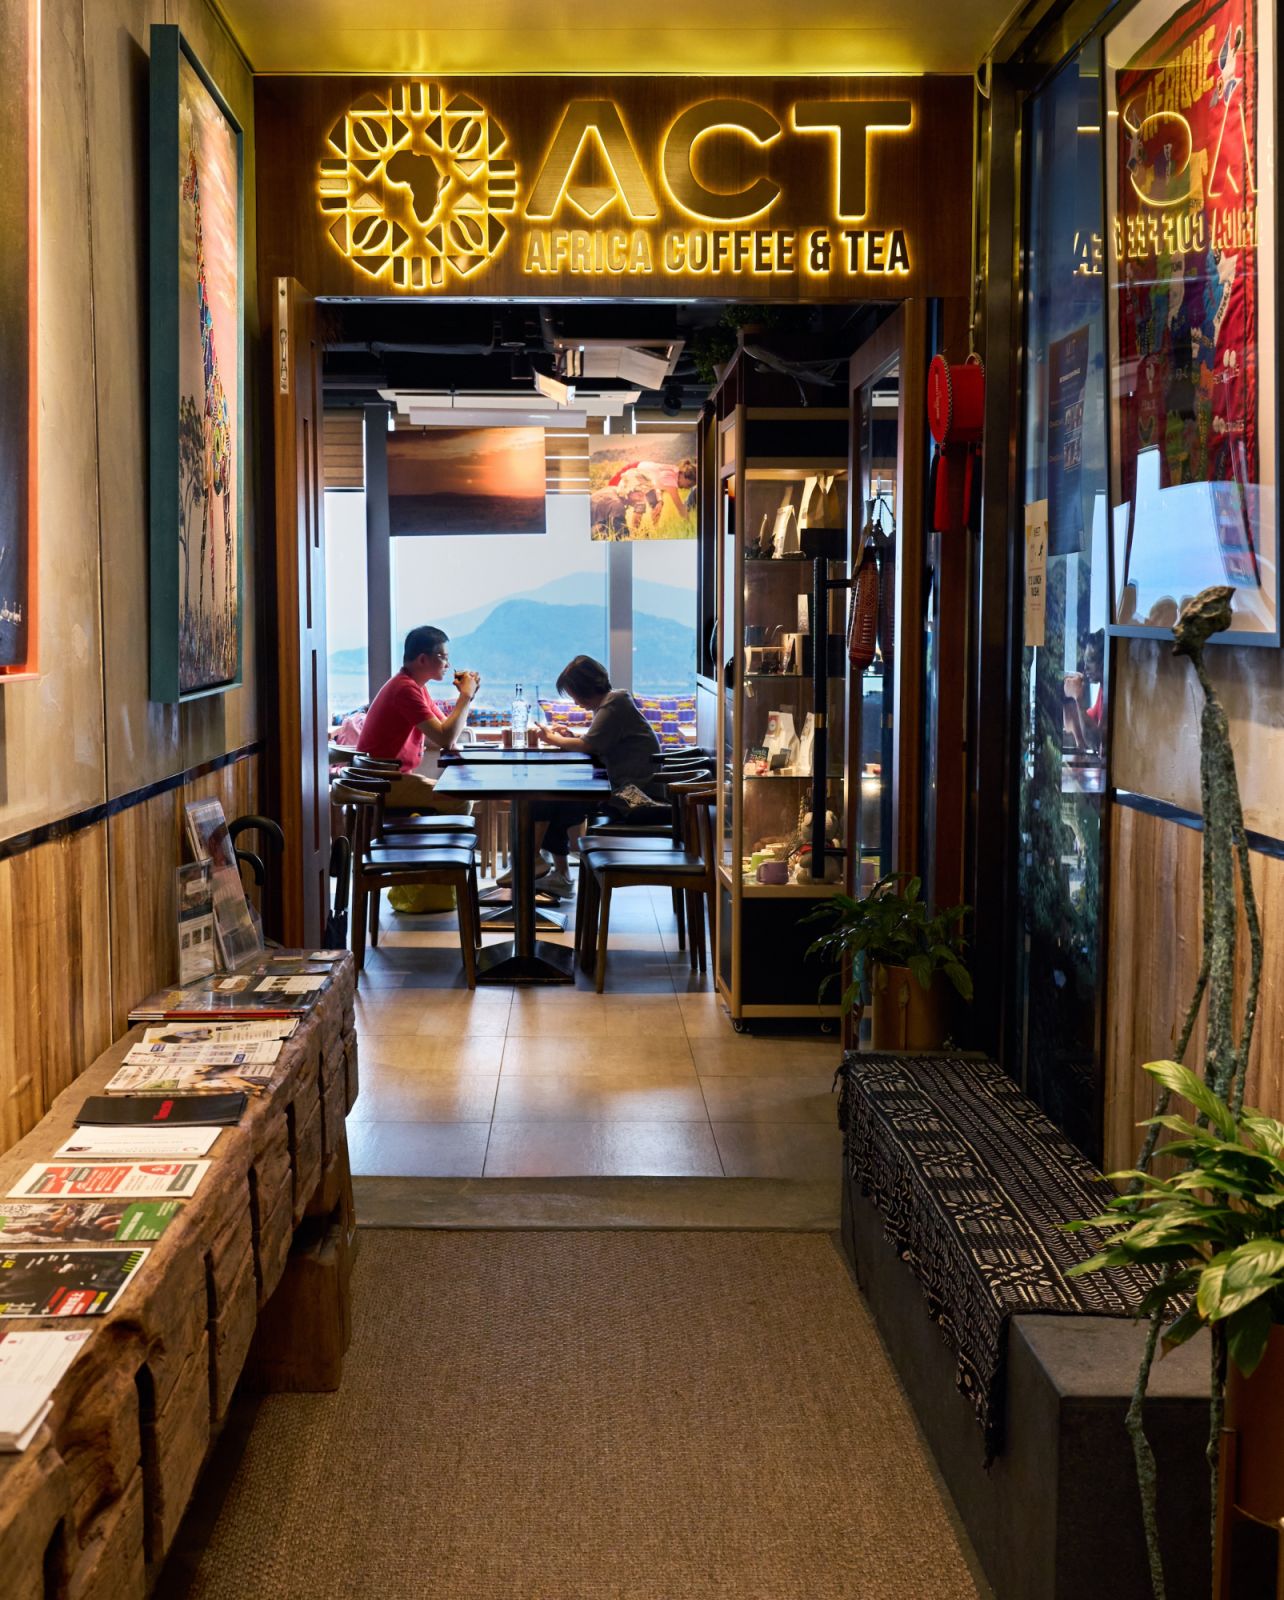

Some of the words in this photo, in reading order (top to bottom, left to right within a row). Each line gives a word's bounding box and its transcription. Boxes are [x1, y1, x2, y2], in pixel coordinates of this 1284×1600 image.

[1143, 25, 1216, 142] AFRIQUE
[524, 99, 914, 222] ACT
[524, 229, 652, 276] AFRICA
[664, 229, 796, 276] COFFEE
[809, 230, 832, 276] &
[843, 229, 911, 276] TEA
